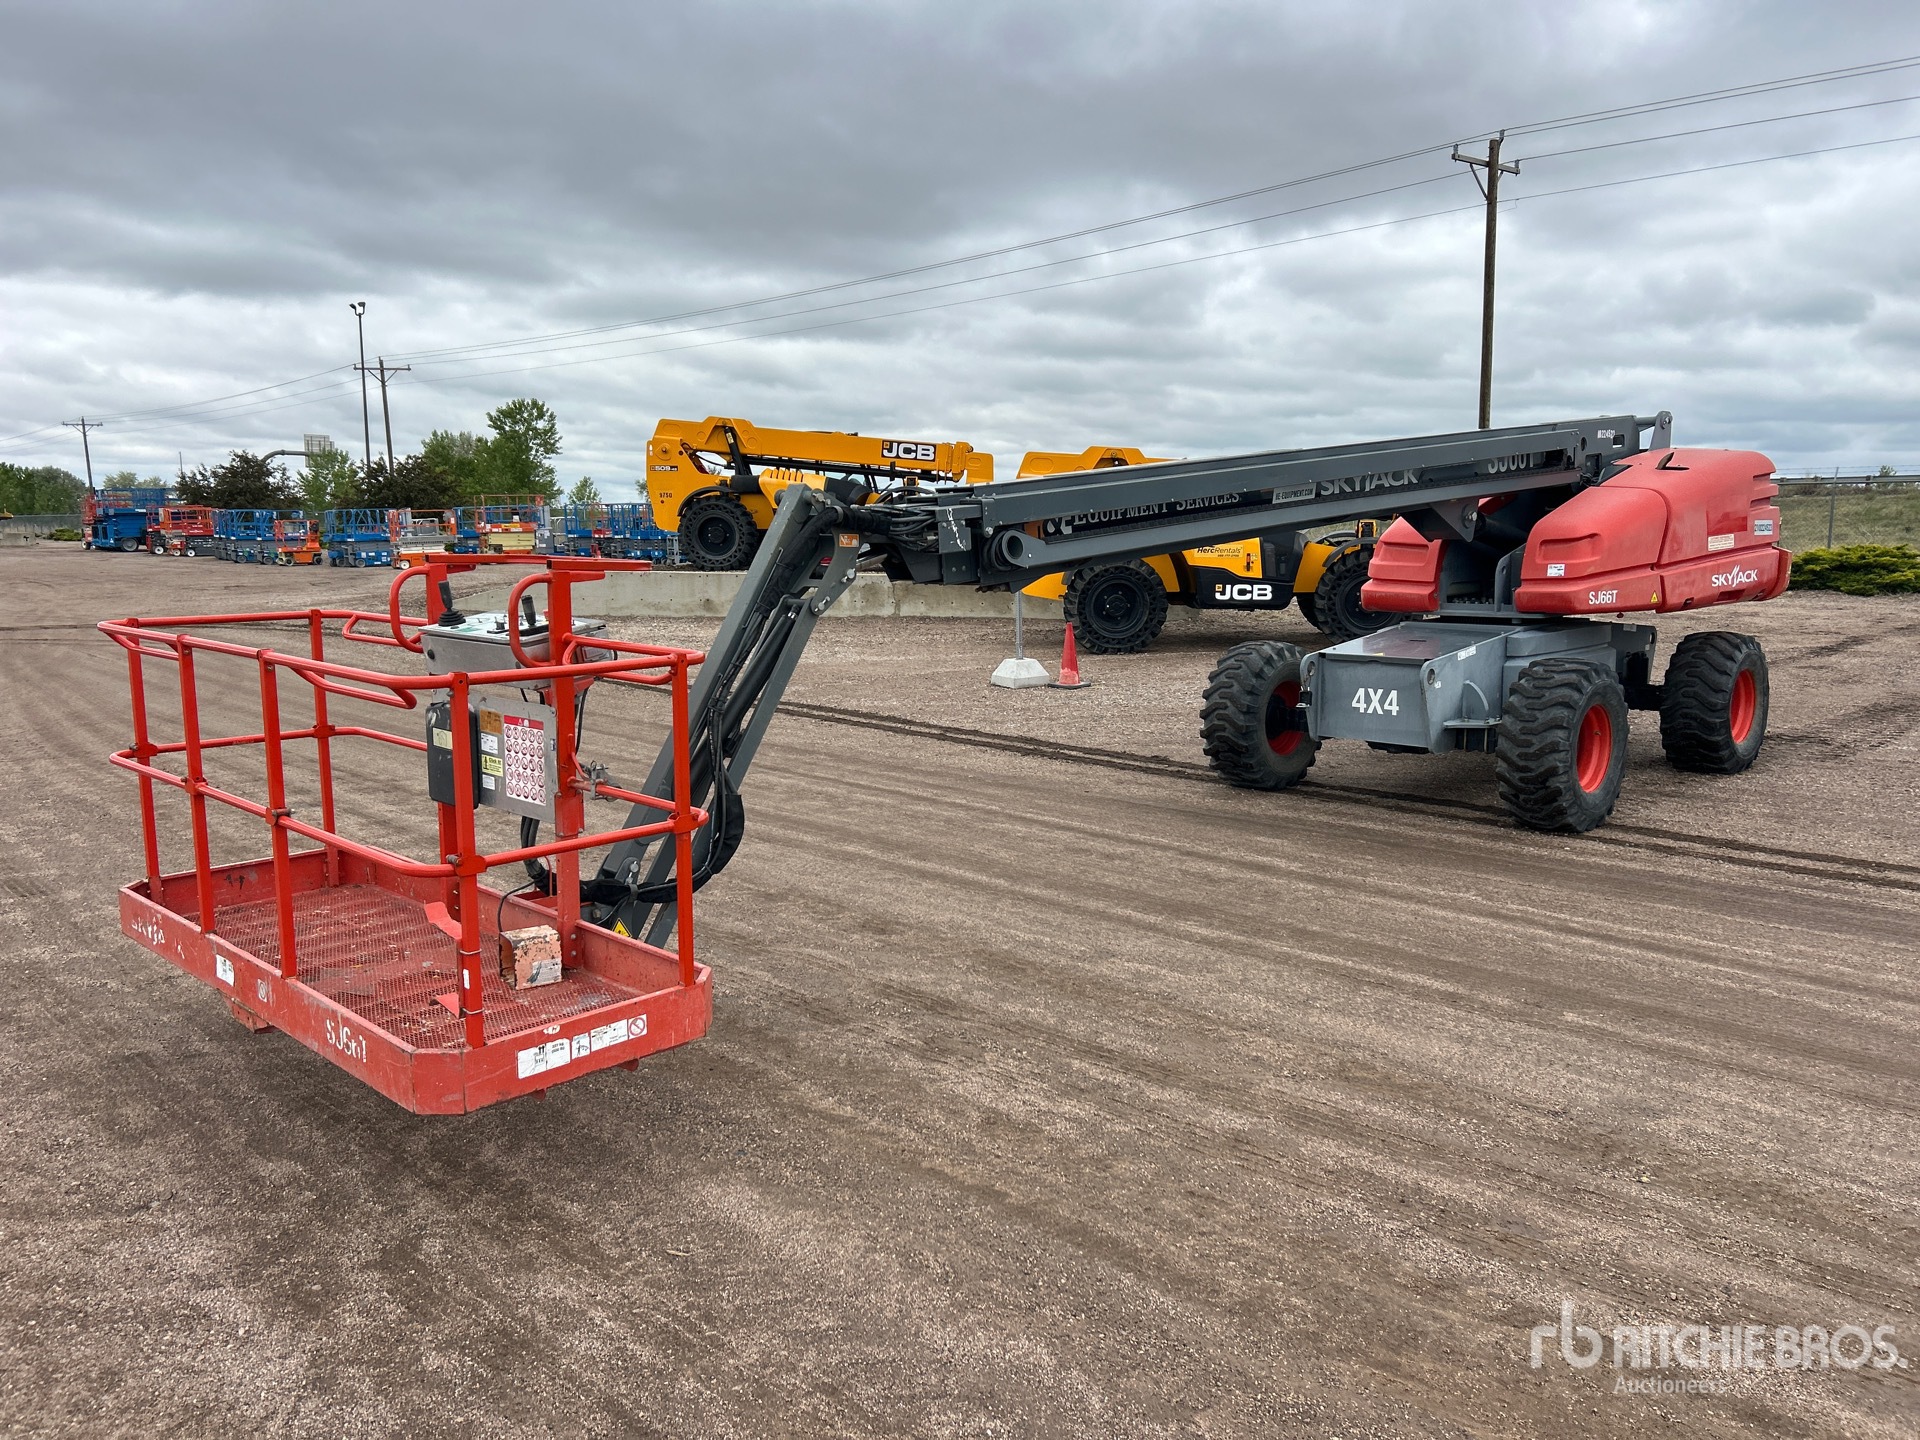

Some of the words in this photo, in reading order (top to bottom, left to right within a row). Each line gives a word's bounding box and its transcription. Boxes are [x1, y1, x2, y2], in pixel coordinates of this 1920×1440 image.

[883, 442, 935, 460] JCB
[1320, 468, 1419, 496] SKYJACK
[1711, 565, 1758, 587] SKYJACK
[1215, 584, 1272, 601] JCB
[1588, 590, 1618, 605] SJ66T
[1351, 687, 1400, 716] 4X4
